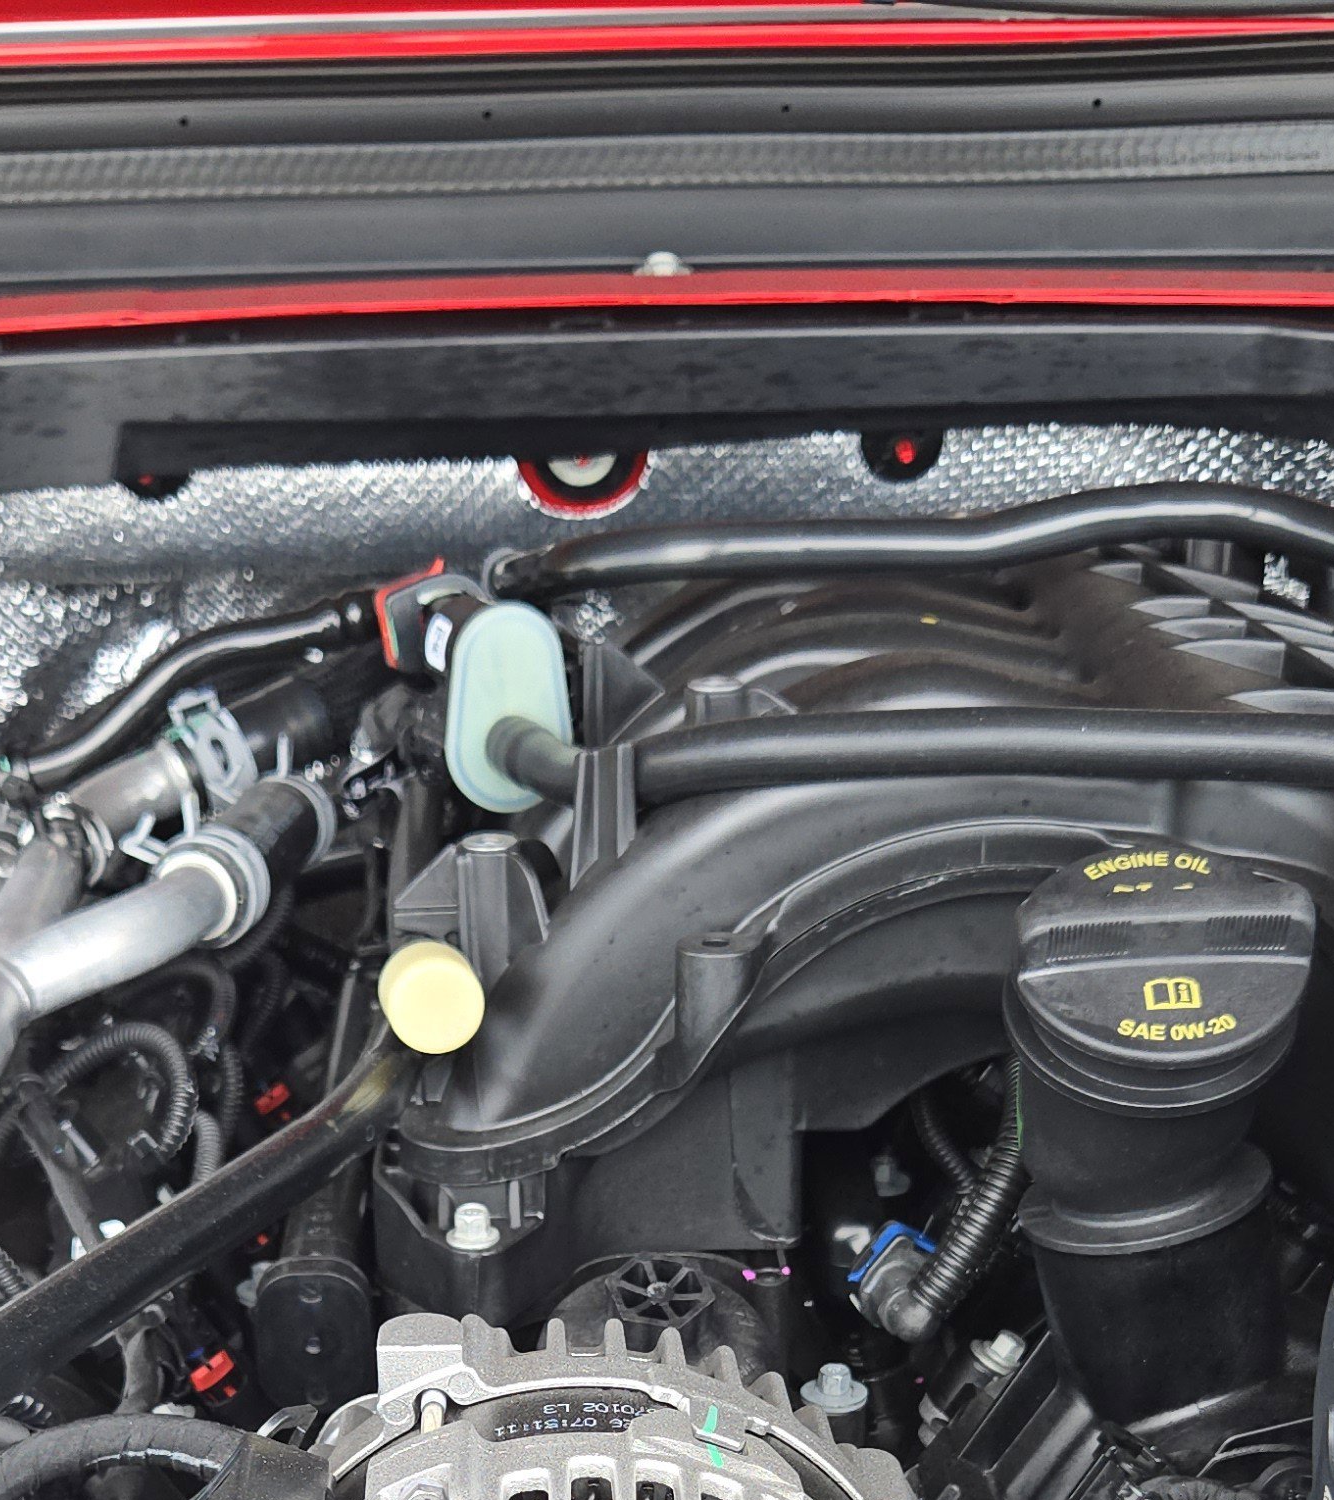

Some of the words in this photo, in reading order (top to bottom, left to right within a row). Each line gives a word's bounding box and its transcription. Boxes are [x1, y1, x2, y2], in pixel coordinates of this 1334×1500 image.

[1083, 851, 1170, 881] ENGINE
[1174, 852, 1212, 876] OIL
[1117, 1019, 1167, 1041] SAE
[1169, 1013, 1237, 1042] 0W-20
